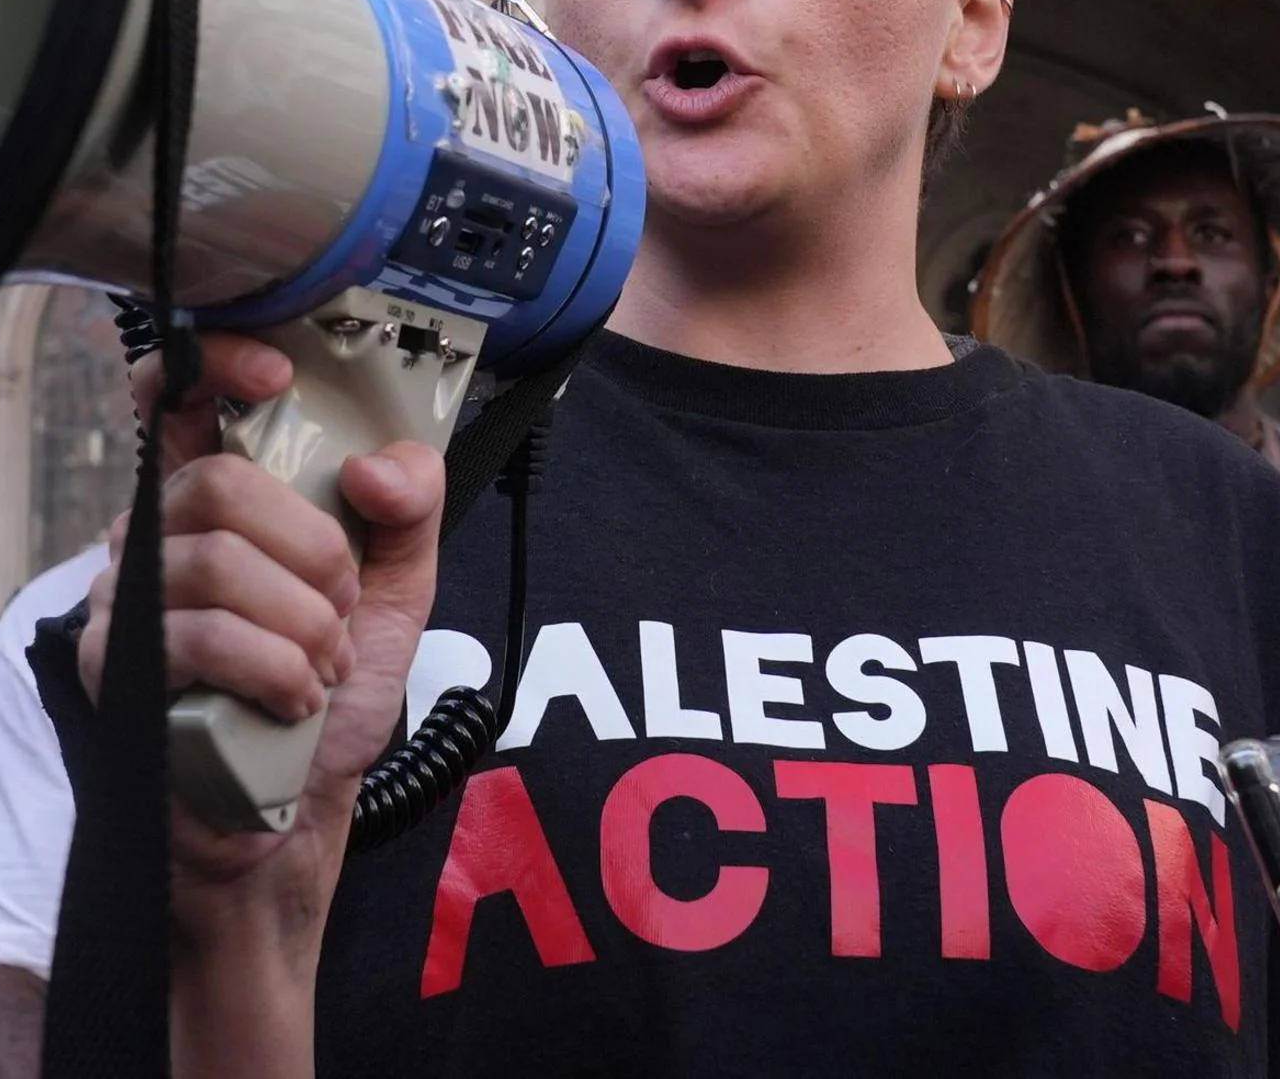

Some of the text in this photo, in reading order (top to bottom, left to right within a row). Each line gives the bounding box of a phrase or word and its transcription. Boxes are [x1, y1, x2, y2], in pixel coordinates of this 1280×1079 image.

[467, 66, 562, 166] NOW
[406, 621, 1226, 828] PALESTINE
[420, 752, 1241, 1034] ACTION
